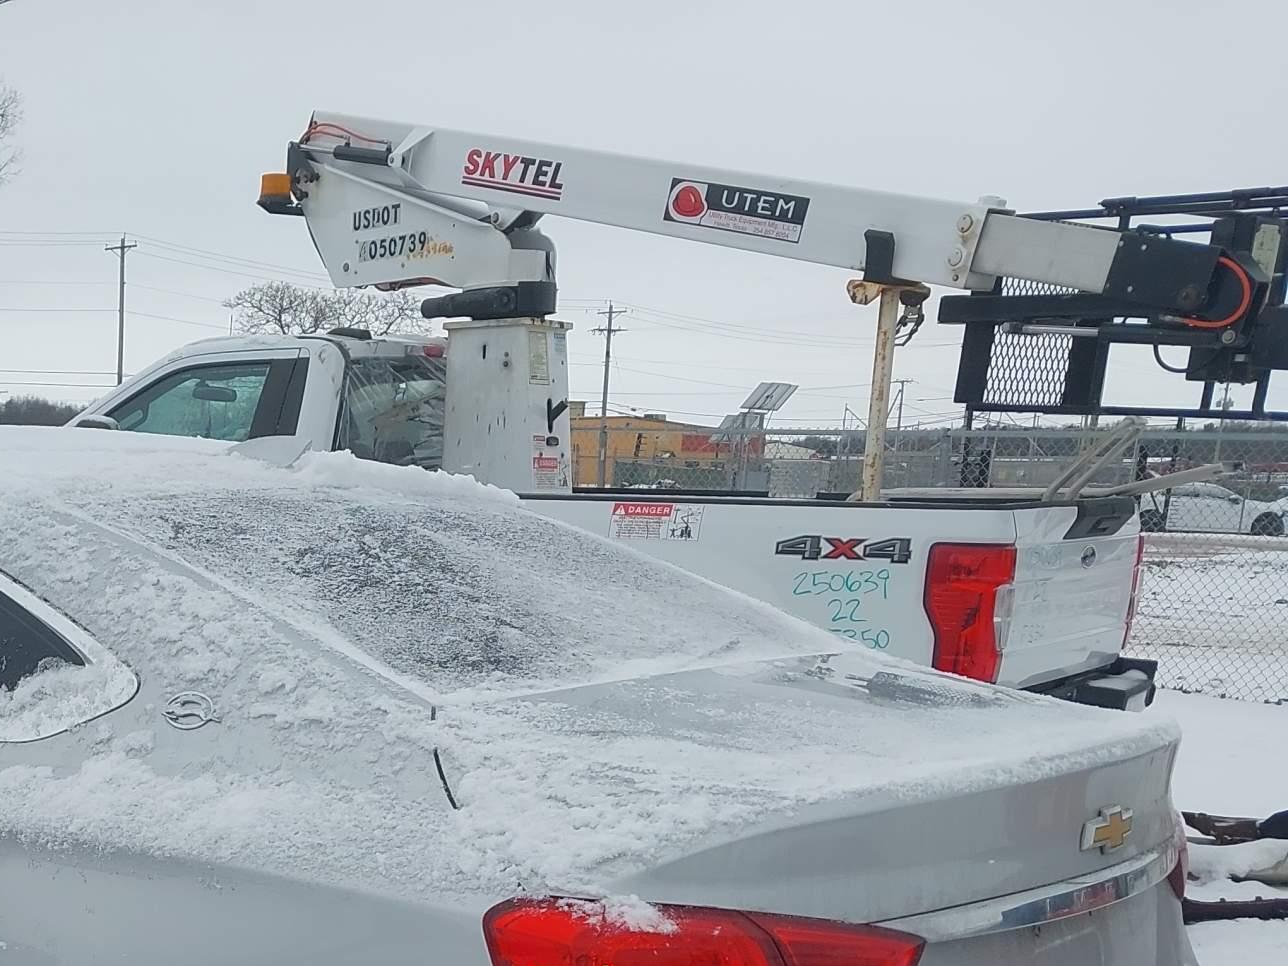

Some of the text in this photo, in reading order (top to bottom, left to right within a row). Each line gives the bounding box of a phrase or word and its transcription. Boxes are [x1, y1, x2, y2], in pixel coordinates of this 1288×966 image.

[463, 148, 564, 190] SKYTEL
[352, 203, 401, 231] USDOT
[721, 189, 796, 219] UTEM
[627, 505, 671, 515] DANGER
[792, 568, 890, 600] 250639
[827, 598, 869, 622] 22
